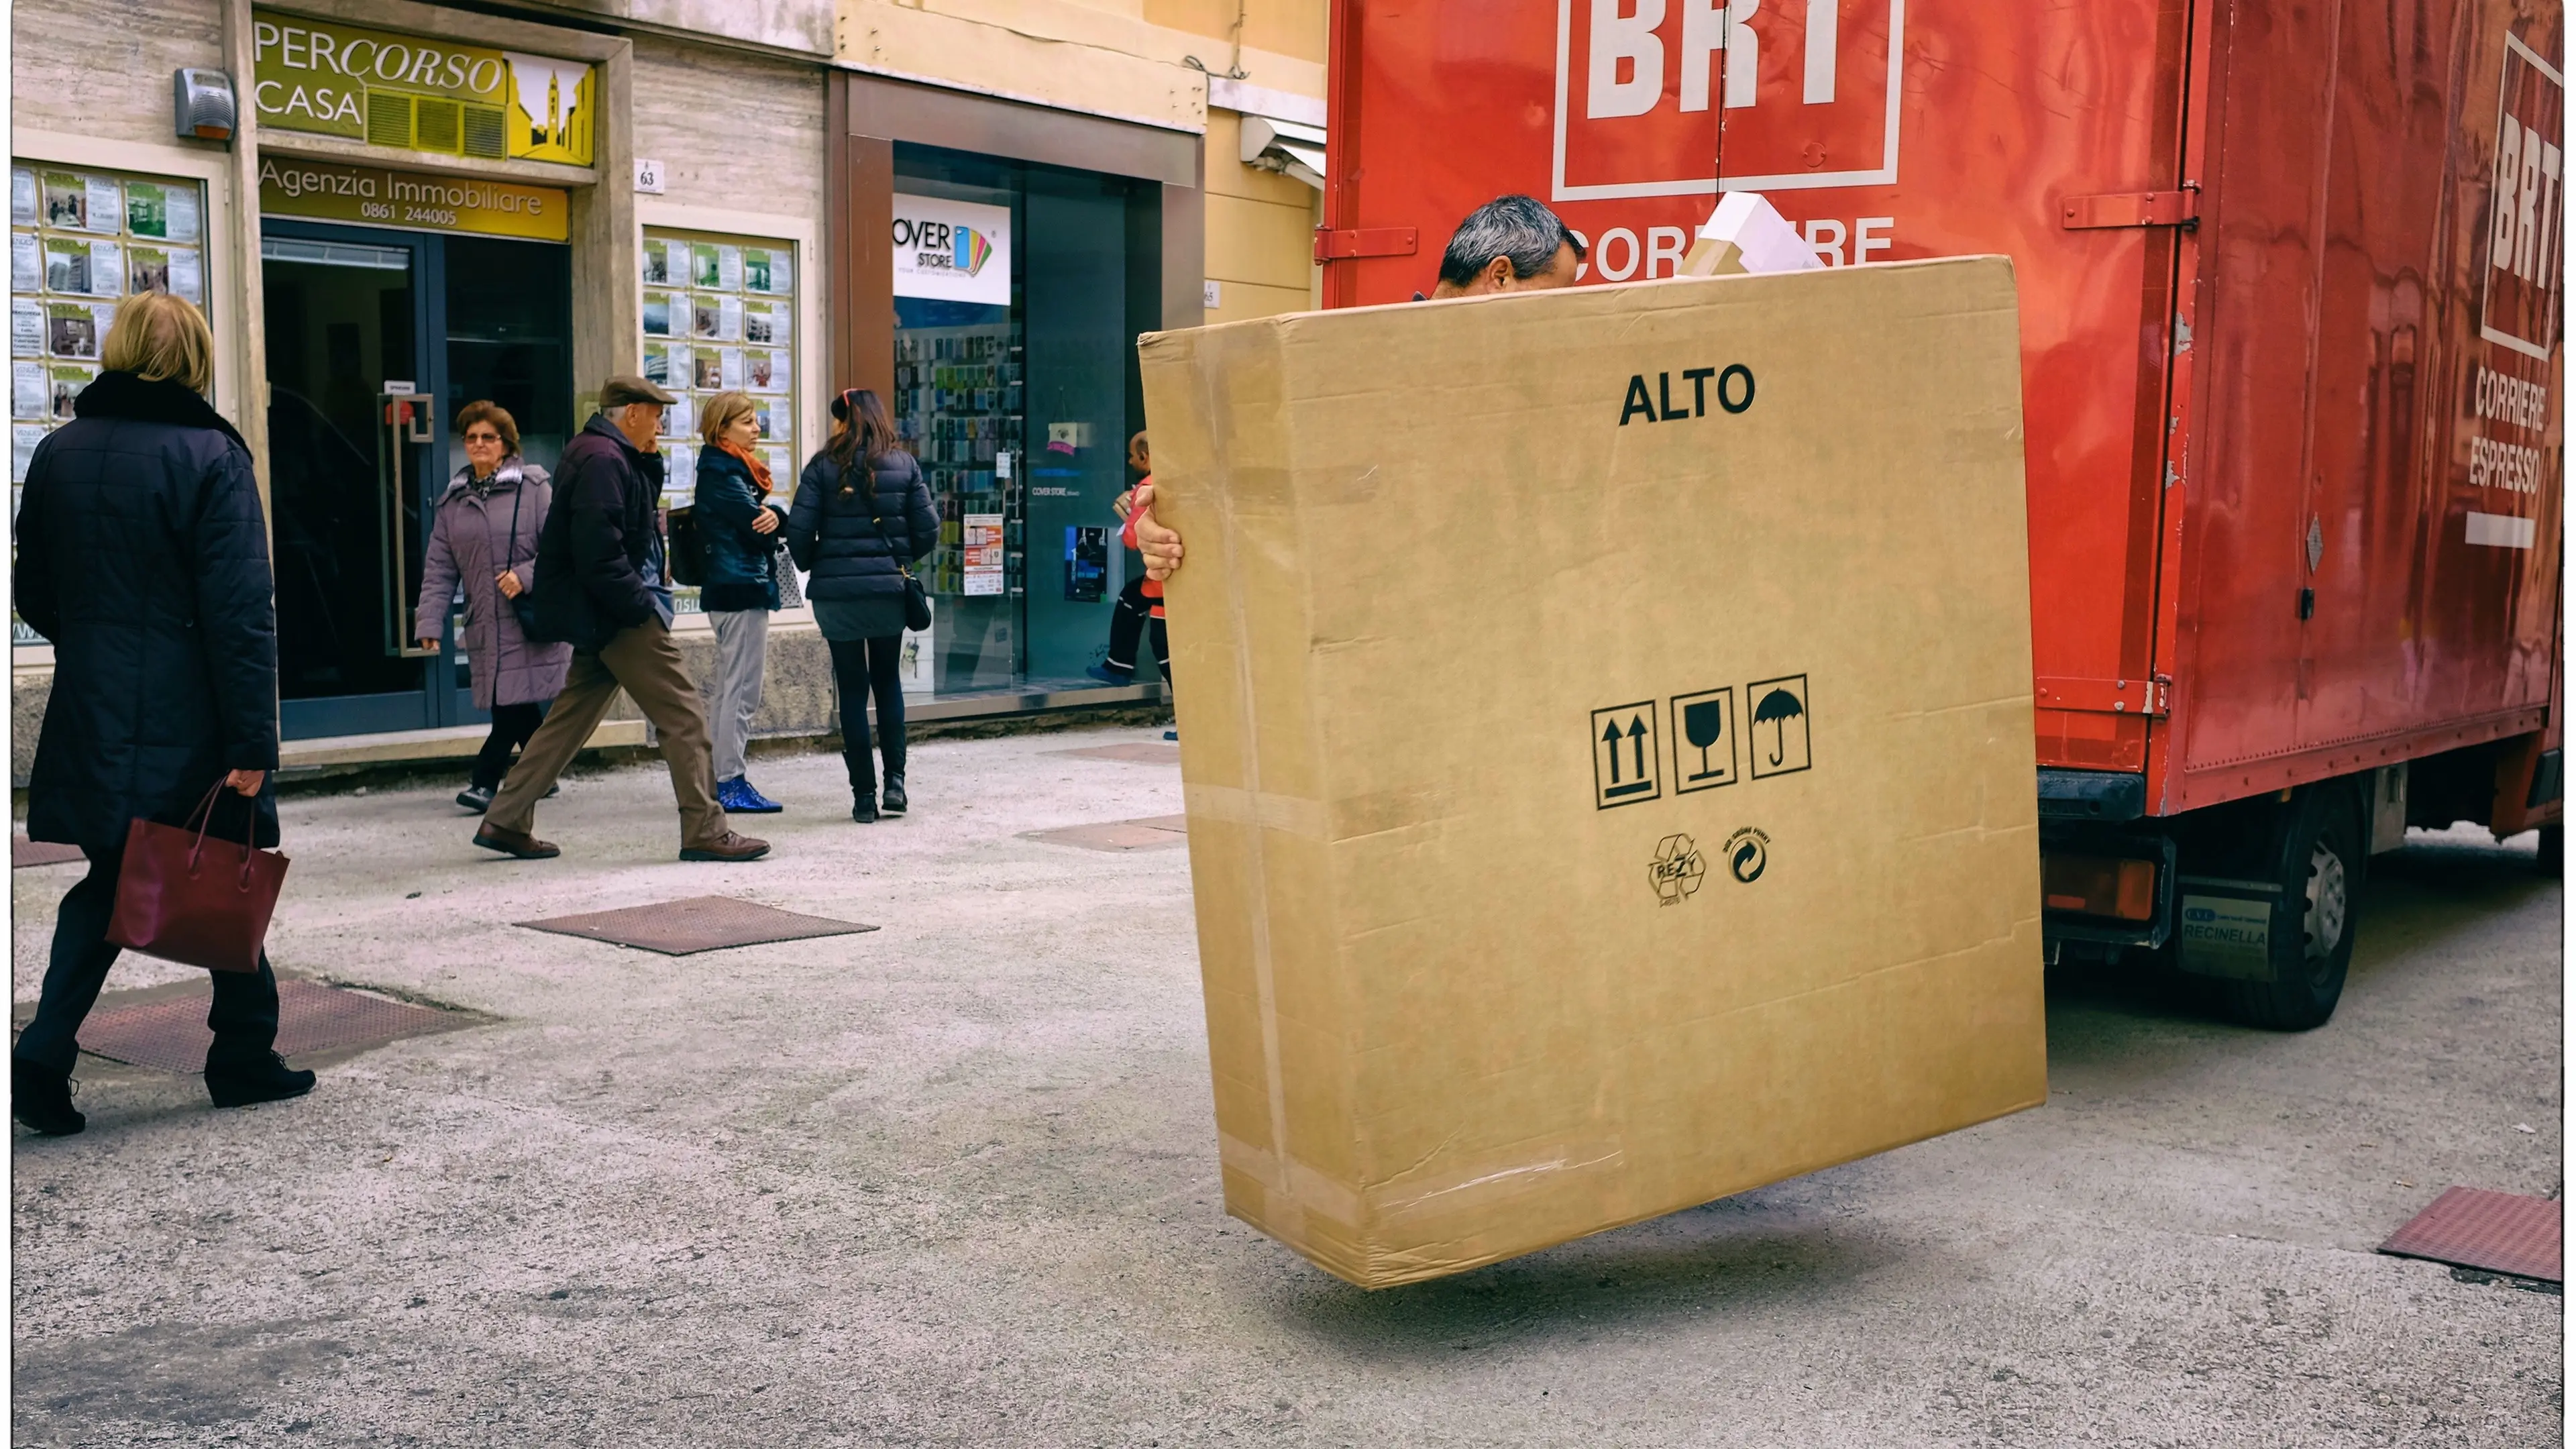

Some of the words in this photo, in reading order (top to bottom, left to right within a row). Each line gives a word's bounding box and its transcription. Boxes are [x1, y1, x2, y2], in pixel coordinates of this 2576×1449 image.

[254, 22, 502, 94] PERCORSO
[255, 80, 362, 125] CASA
[259, 159, 376, 197] Agenzia
[388, 172, 541, 215] Immobiliare
[640, 171, 654, 186] 63
[2492, 111, 2561, 290] BRT
[361, 202, 396, 219] 0861
[405, 206, 456, 225] 244005
[918, 252, 953, 268] STORE
[1617, 363, 1756, 427] ALTO
[2475, 366, 2546, 432] CORRIERE
[2469, 435, 2540, 495] ESPRESSO
[2184, 924, 2266, 946] RECINELLA
